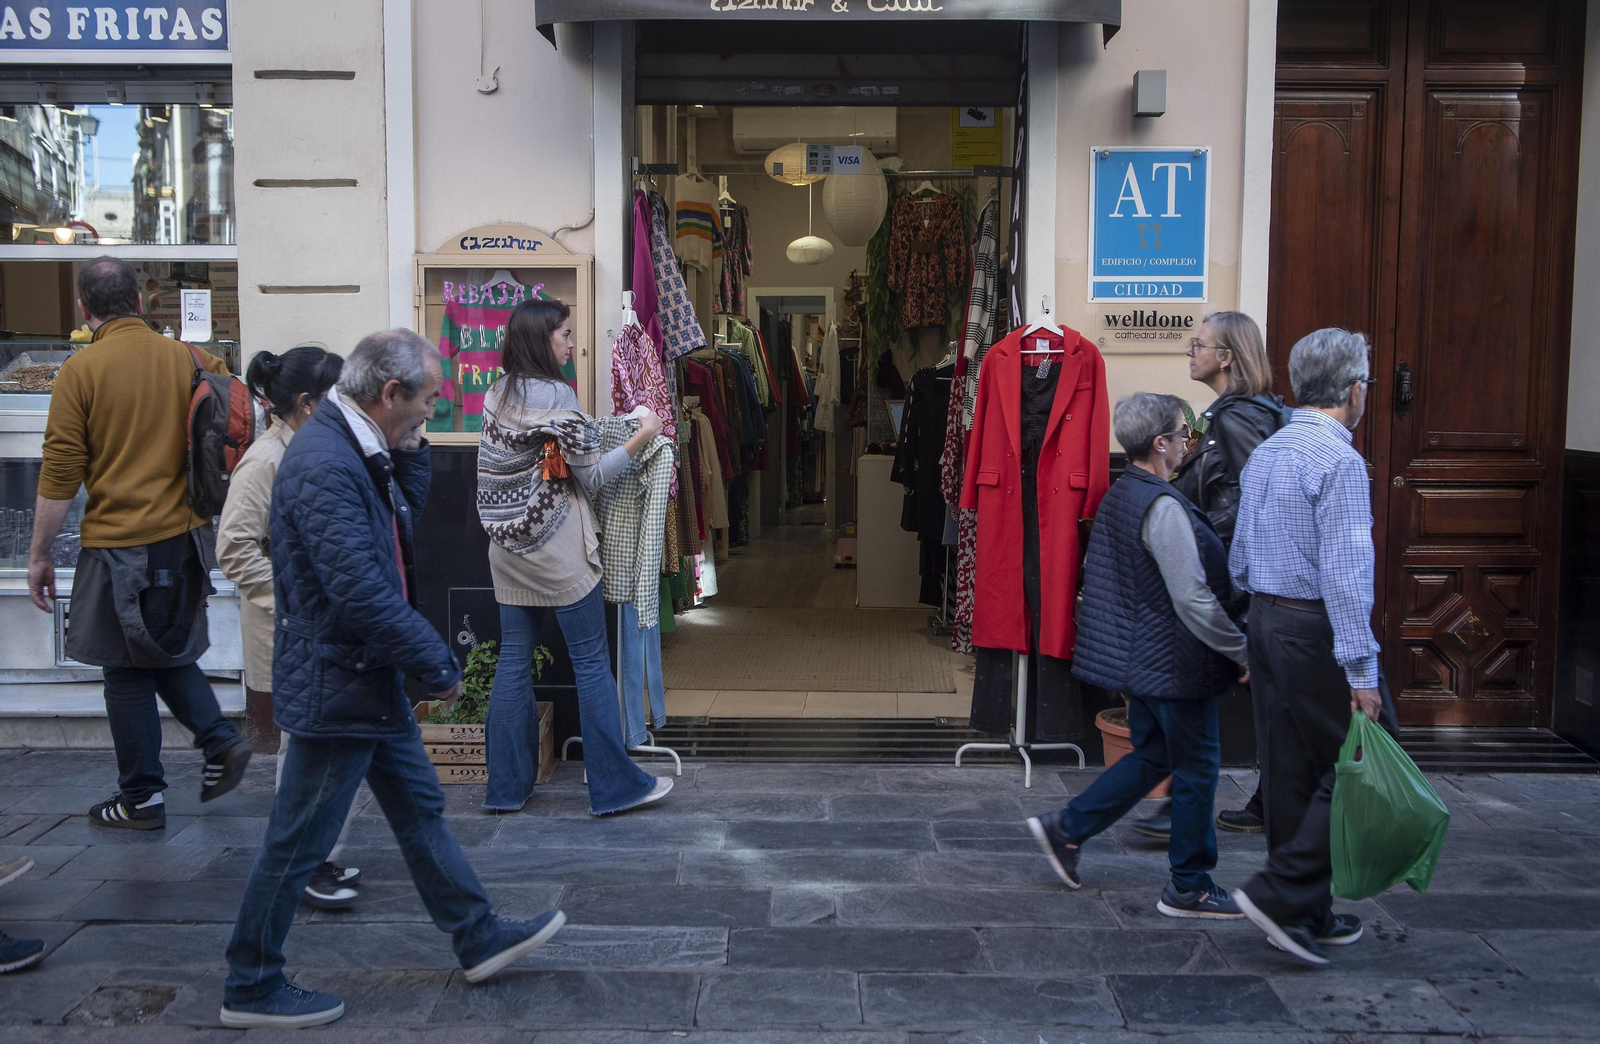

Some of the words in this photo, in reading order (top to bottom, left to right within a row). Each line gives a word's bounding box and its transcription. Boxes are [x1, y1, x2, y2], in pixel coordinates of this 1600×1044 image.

[0, 7, 52, 41] AS
[67, 7, 224, 41] FRITAS
[837, 155, 860, 165] VISA
[1109, 161, 1192, 218] AT
[1101, 257, 1142, 266] EDIFICIO
[1149, 257, 1197, 267] COMPLEJO
[442, 280, 544, 306] REBAJAS
[1114, 283, 1183, 296] CIUDAD
[1104, 310, 1194, 328] welldone
[460, 323, 506, 349] BLA
[1115, 330, 1157, 340] cathedral
[1158, 330, 1183, 340] suites
